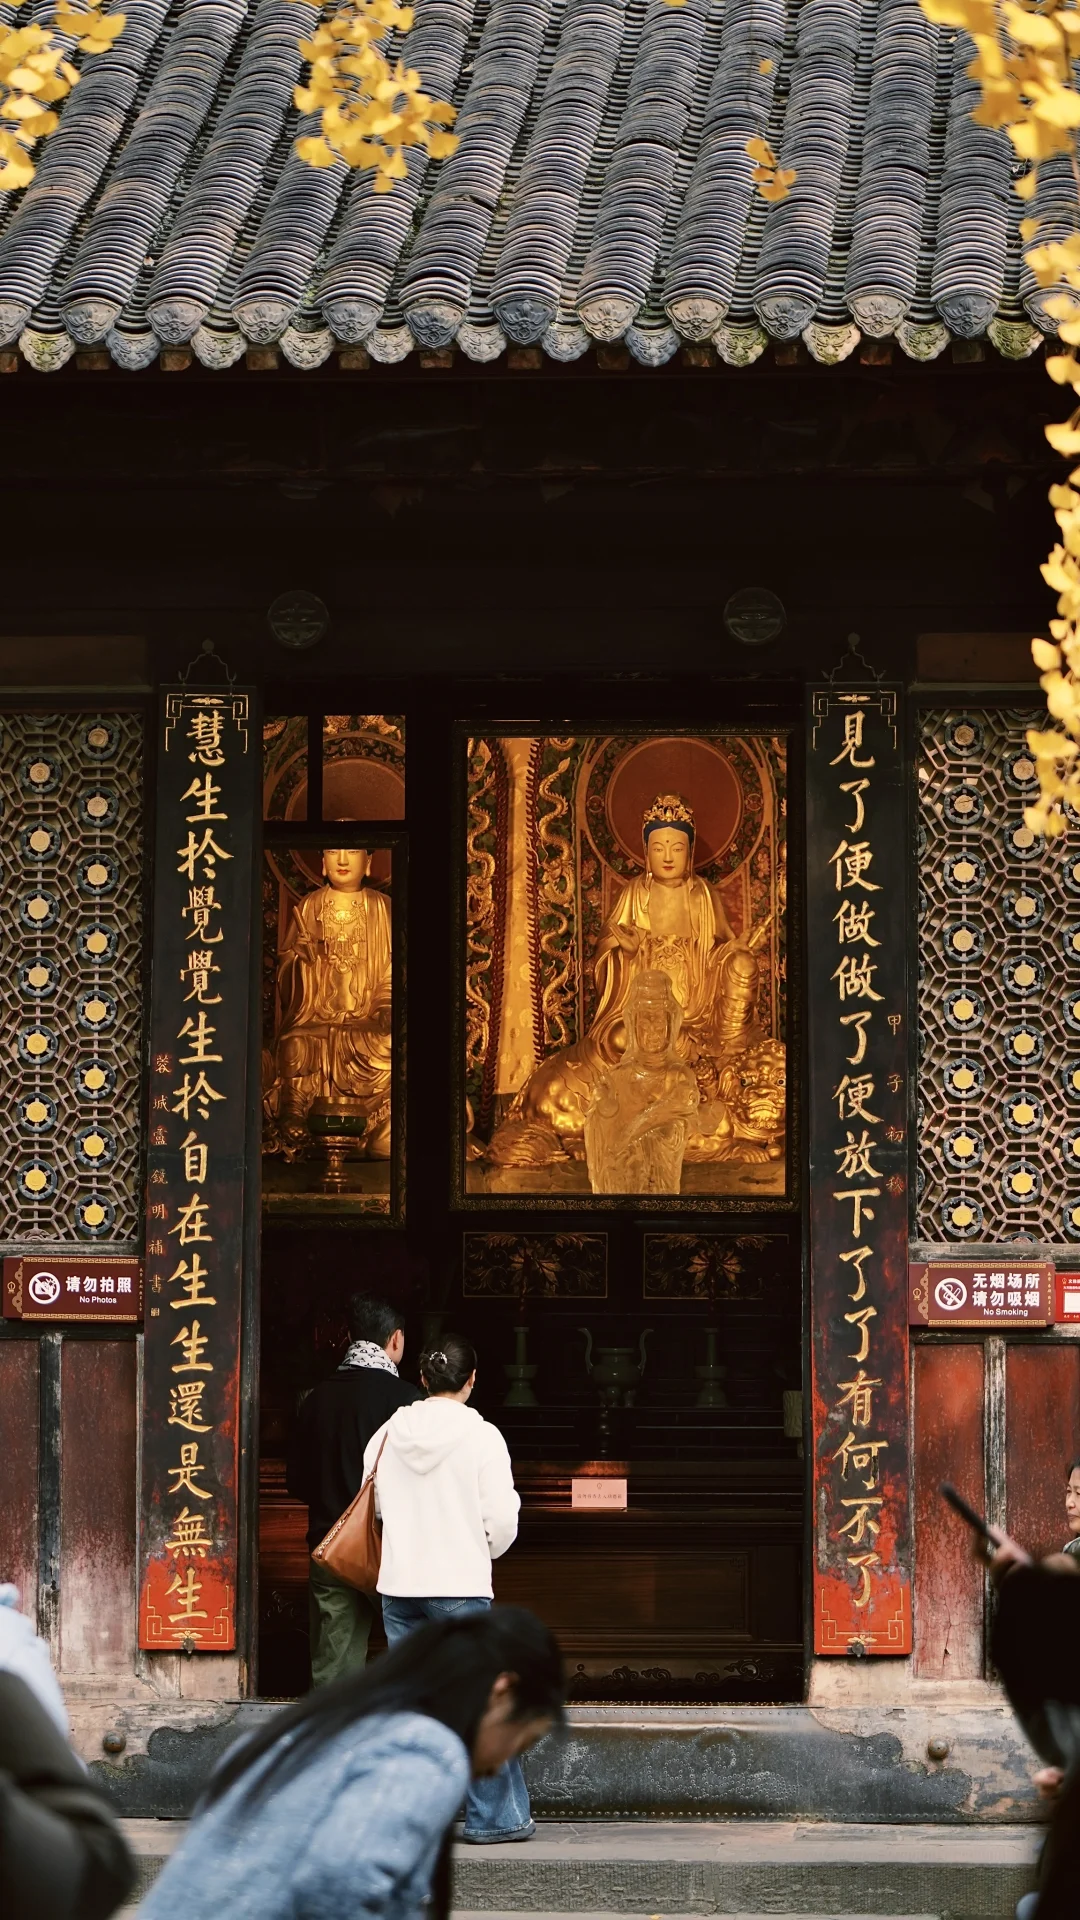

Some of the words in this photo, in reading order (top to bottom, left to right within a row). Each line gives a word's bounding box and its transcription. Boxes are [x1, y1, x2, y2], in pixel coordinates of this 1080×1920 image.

[829, 710, 889, 1608] 見了便做做了便放下了了有何不了
[65, 1276, 132, 1293] 请勿拍照
[972, 1273, 1040, 1289] 无烟场所
[79, 1296, 91, 1304] No
[91, 1296, 117, 1304] Photos
[972, 1291, 1040, 1307] 请勿吸烟
[983, 1308, 994, 1316] No
[995, 1308, 1029, 1317] Smoking
